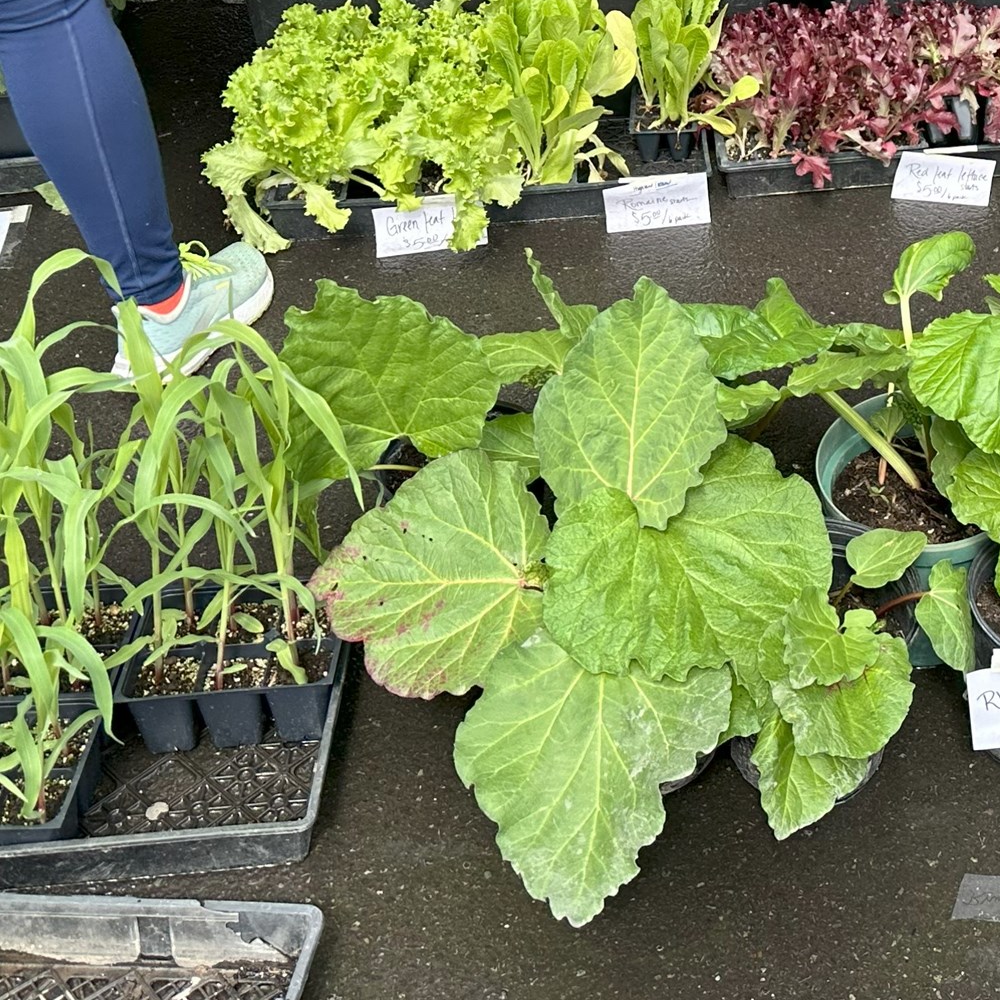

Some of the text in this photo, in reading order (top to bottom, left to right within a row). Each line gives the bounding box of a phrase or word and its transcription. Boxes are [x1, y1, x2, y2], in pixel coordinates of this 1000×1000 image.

[906, 163, 988, 185] Red leaf lettuce
[616, 196, 669, 212] Romaine
[386, 215, 420, 237] Green
[423, 210, 446, 234] leaf
